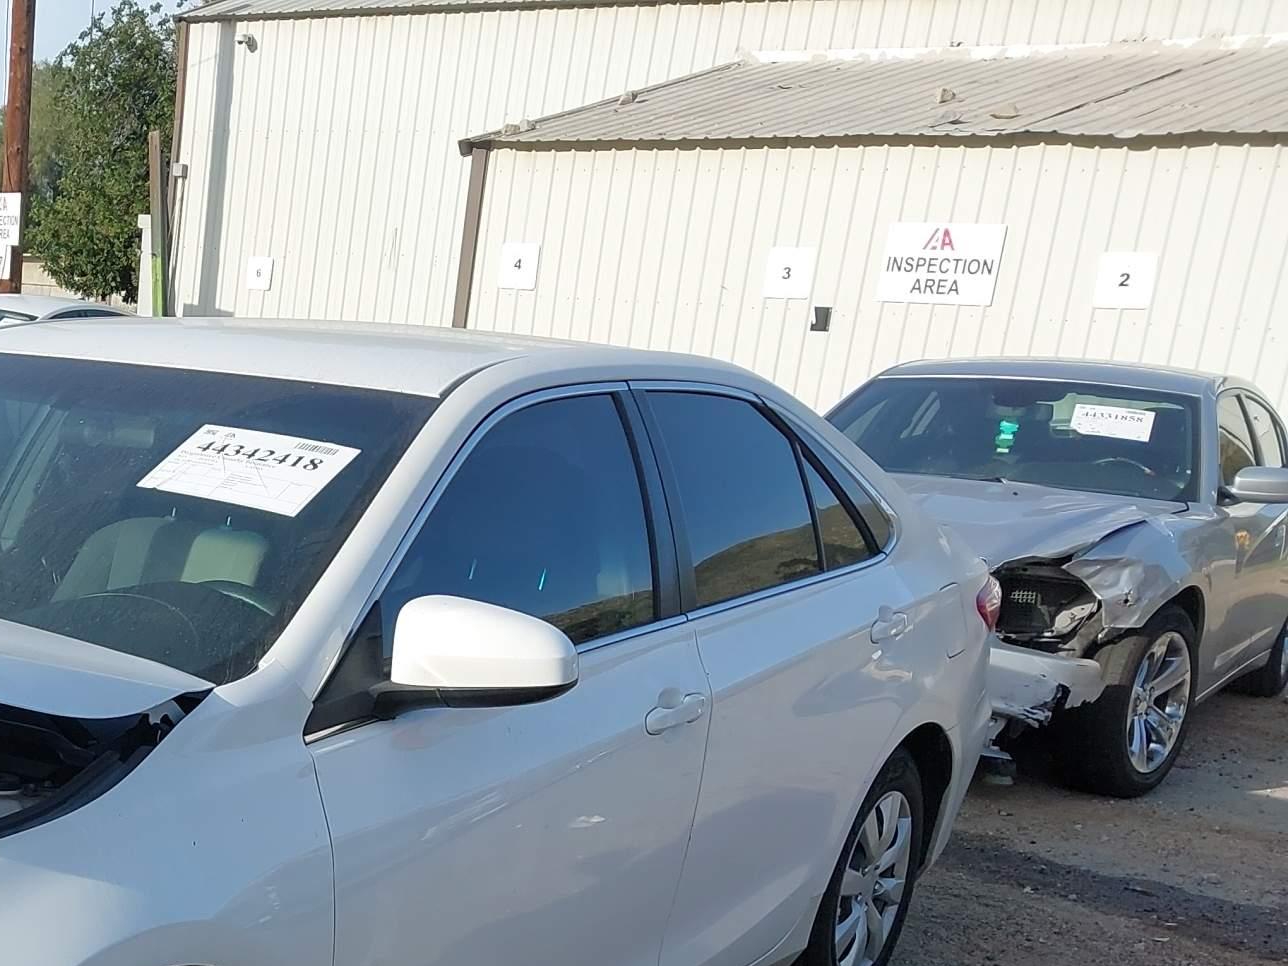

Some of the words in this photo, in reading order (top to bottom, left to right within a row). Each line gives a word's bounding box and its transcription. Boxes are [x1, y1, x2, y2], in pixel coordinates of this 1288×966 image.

[513, 258, 522, 270] 4
[886, 256, 994, 275] INSPECTION
[782, 266, 792, 280] 3
[1118, 273, 1131, 287] 2
[909, 278, 960, 295] AREA
[196, 440, 324, 472] 44342418
